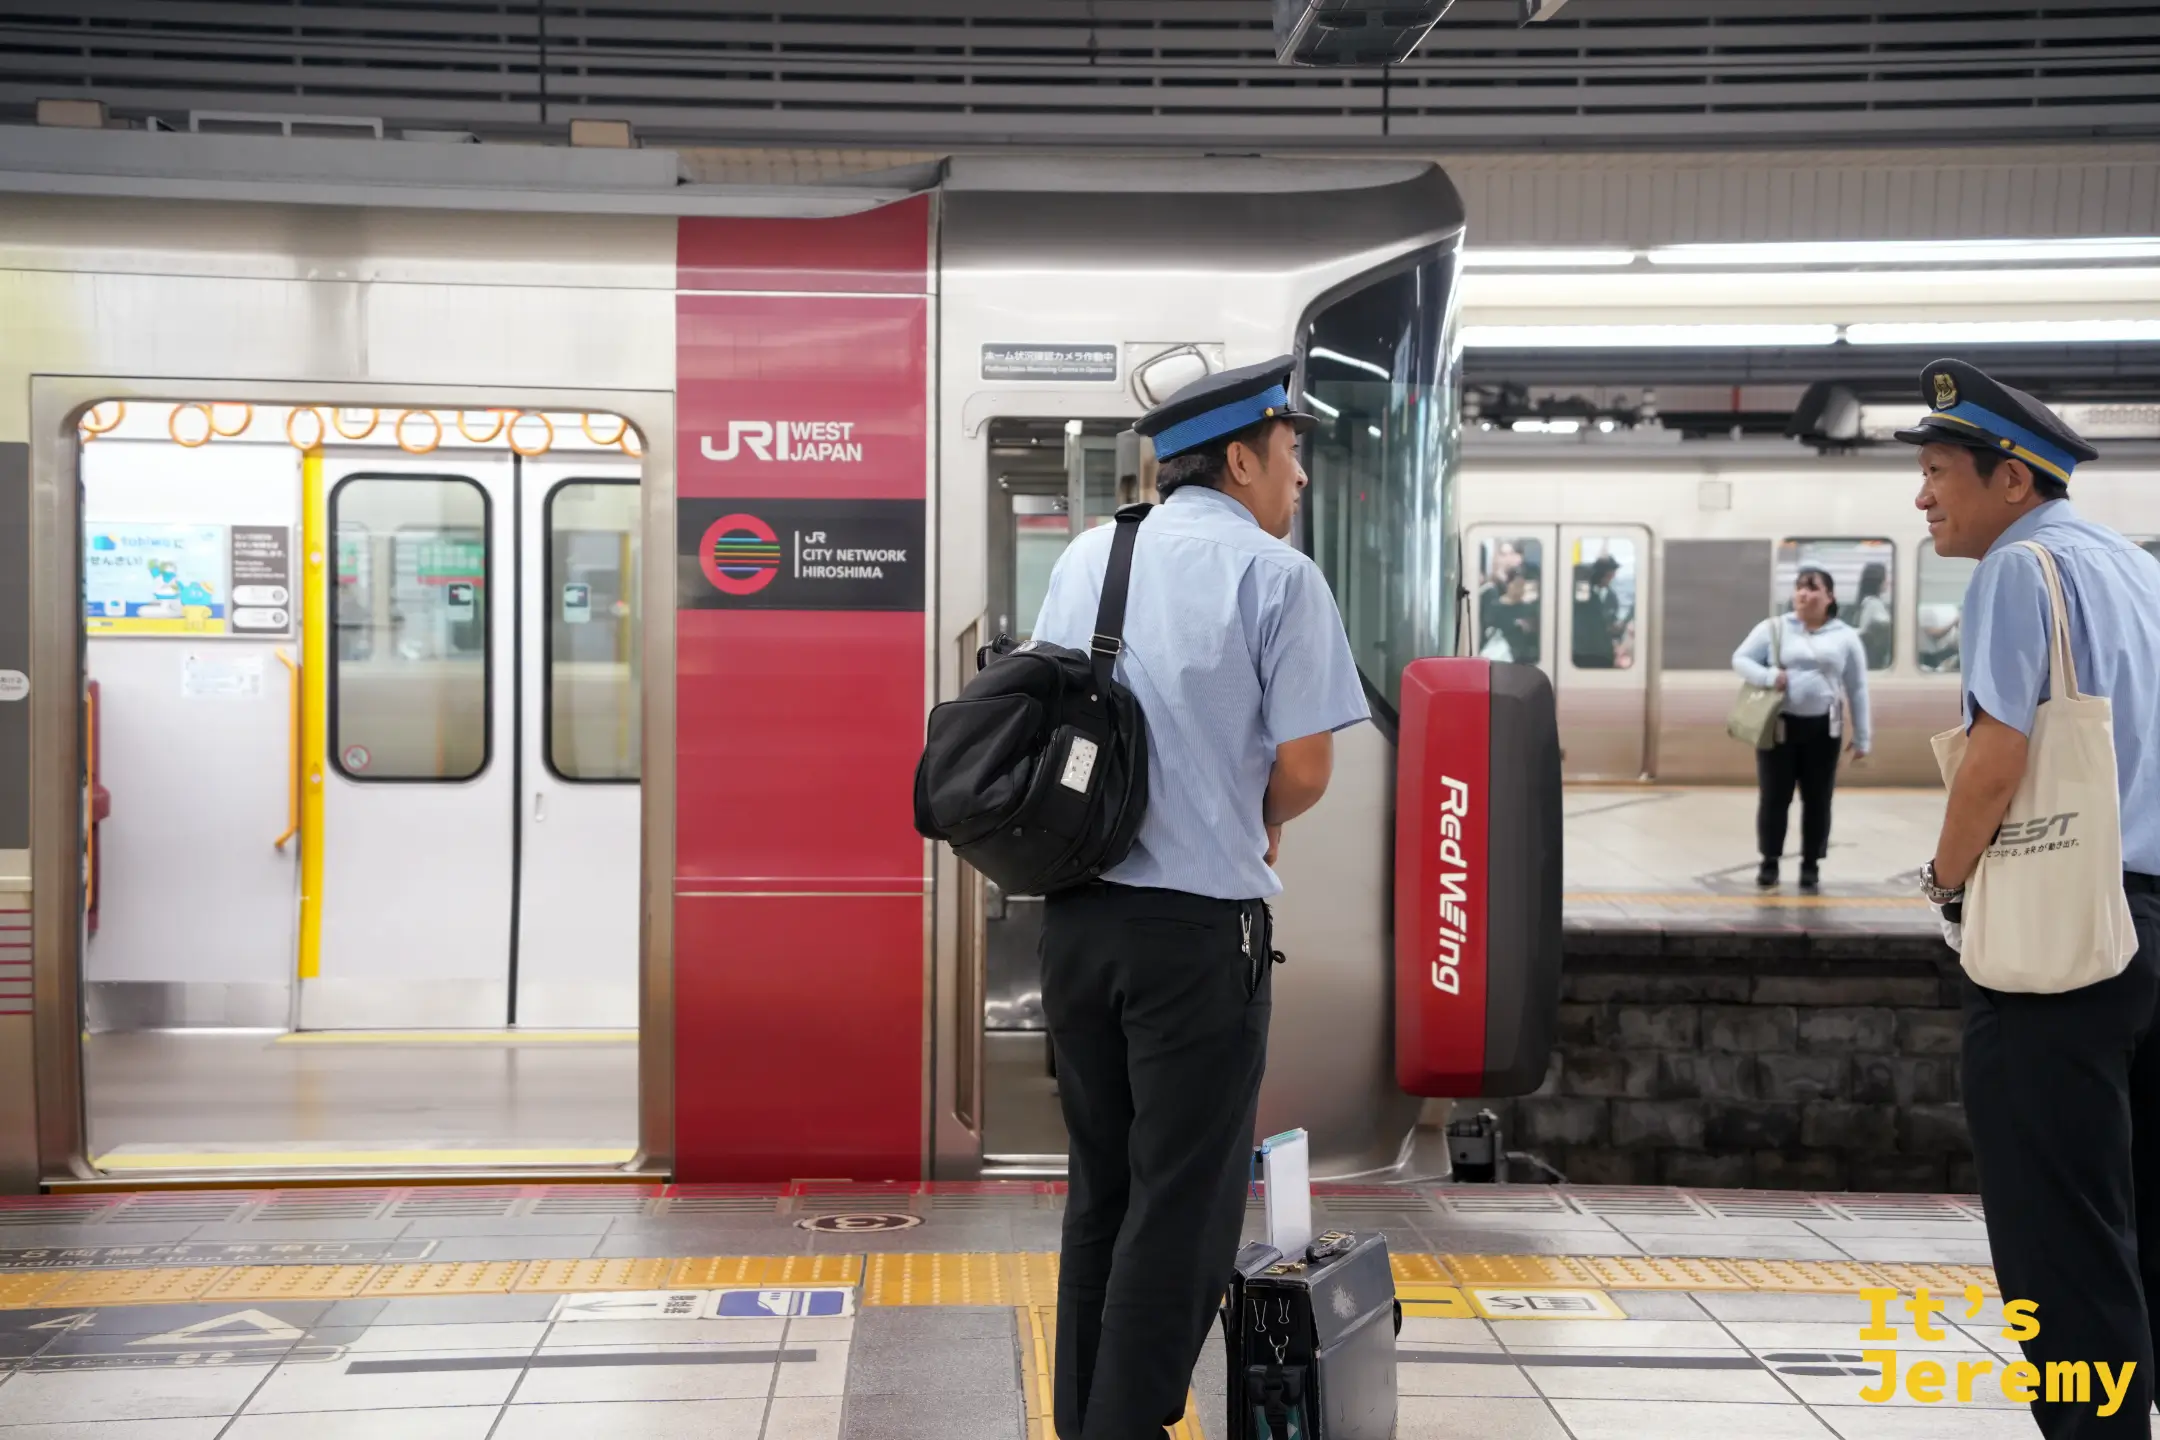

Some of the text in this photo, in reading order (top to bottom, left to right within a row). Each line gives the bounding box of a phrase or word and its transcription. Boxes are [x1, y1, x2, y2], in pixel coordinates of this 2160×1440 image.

[790, 421, 855, 441] WEST
[790, 443, 863, 462] JAPAN
[805, 531, 827, 544] JR
[802, 549, 907, 562] CITY NETWORK
[802, 565, 884, 579] HIROSHIMA
[1990, 811, 2080, 847] EST
